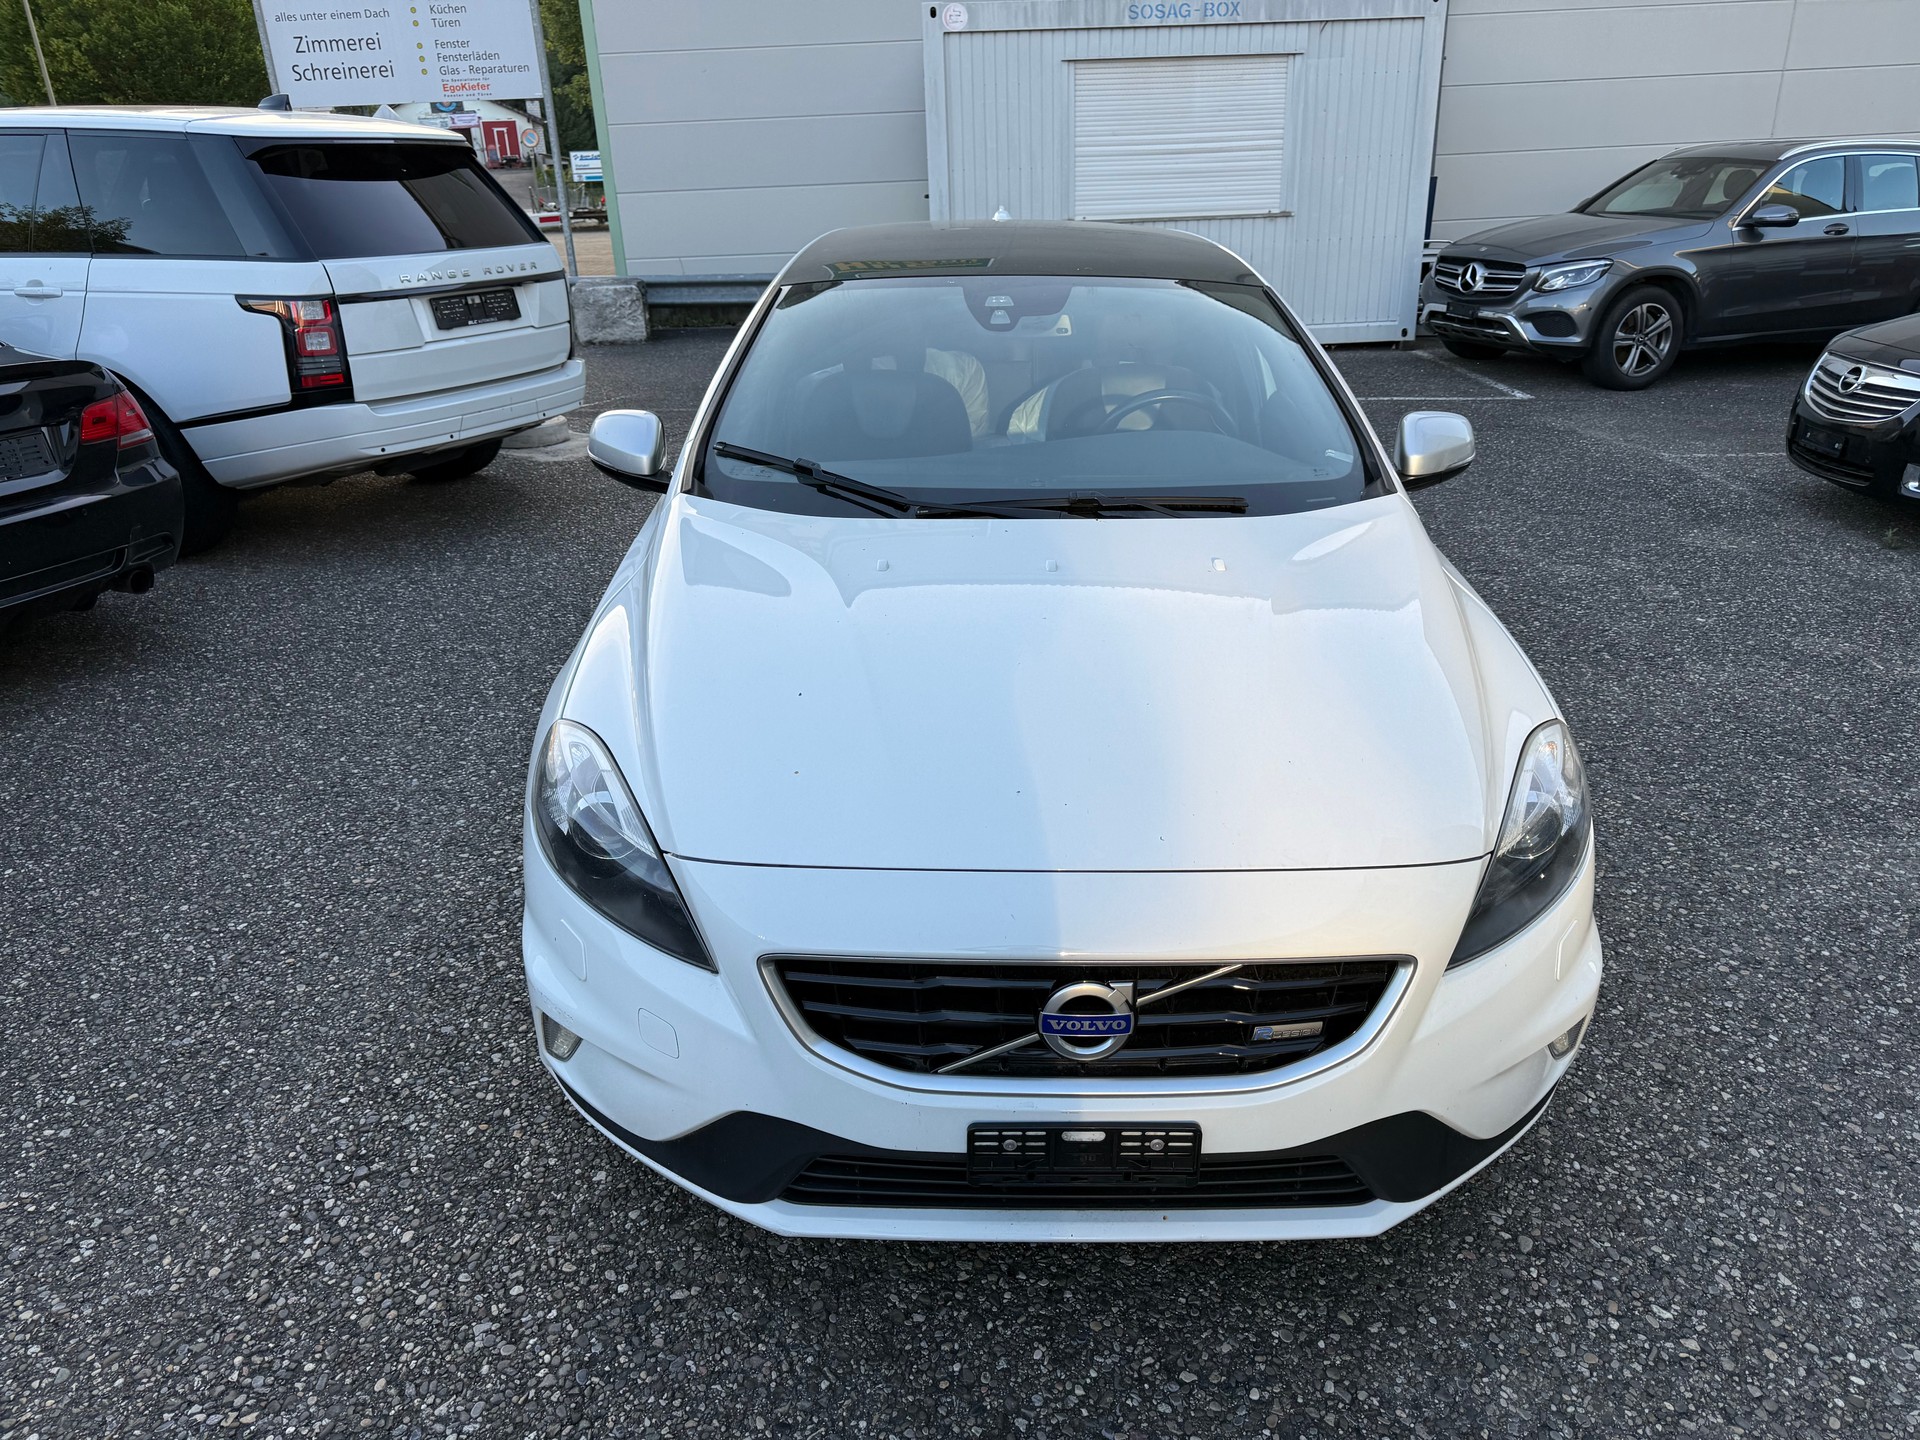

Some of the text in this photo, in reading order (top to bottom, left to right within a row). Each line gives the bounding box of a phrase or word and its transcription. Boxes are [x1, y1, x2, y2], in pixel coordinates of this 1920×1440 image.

[274, 8, 390, 22] alles unter einem Dach
[429, 4, 467, 15] Küchen
[1128, 2, 1241, 20] SOSAG-BOX
[431, 18, 461, 28] Türen
[293, 32, 381, 53] Zimmerei
[434, 39, 470, 49] Fenster
[436, 51, 500, 62] Fensterläden
[291, 60, 394, 81] Schreinerei
[439, 65, 460, 76] Glas
[468, 64, 530, 76] Reparaturen
[442, 82, 491, 93] EgoKiefer
[399, 261, 538, 284] RANGE ROVER
[1047, 1019, 1127, 1031] VOLVO
